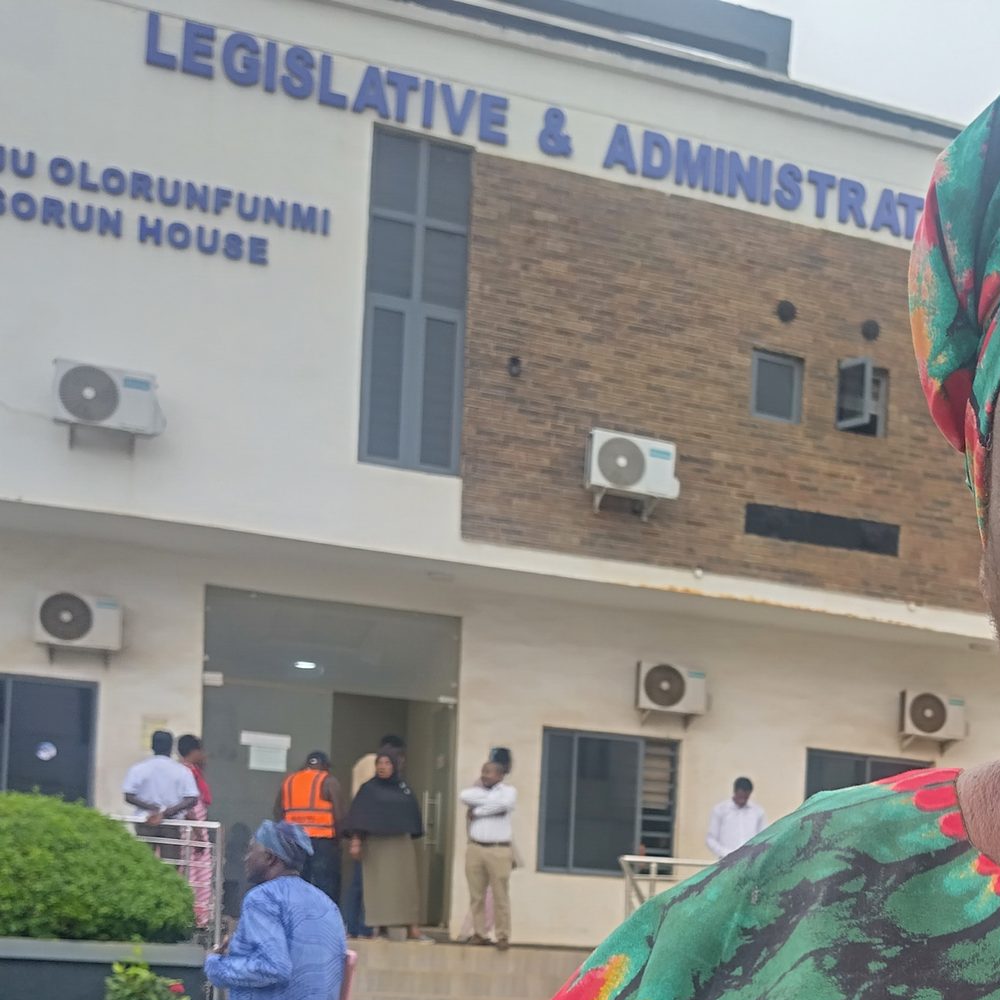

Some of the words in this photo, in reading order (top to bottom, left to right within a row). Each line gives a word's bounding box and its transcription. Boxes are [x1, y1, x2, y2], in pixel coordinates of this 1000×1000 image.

[145, 12, 508, 146] LEGISLATIVE
[537, 107, 573, 157] &
[603, 123, 925, 240] ADMINISTRAT
[0, 189, 122, 238] ORUN
[138, 216, 269, 266] HOUSE
[49, 157, 331, 236] OLORUNFUNMI
